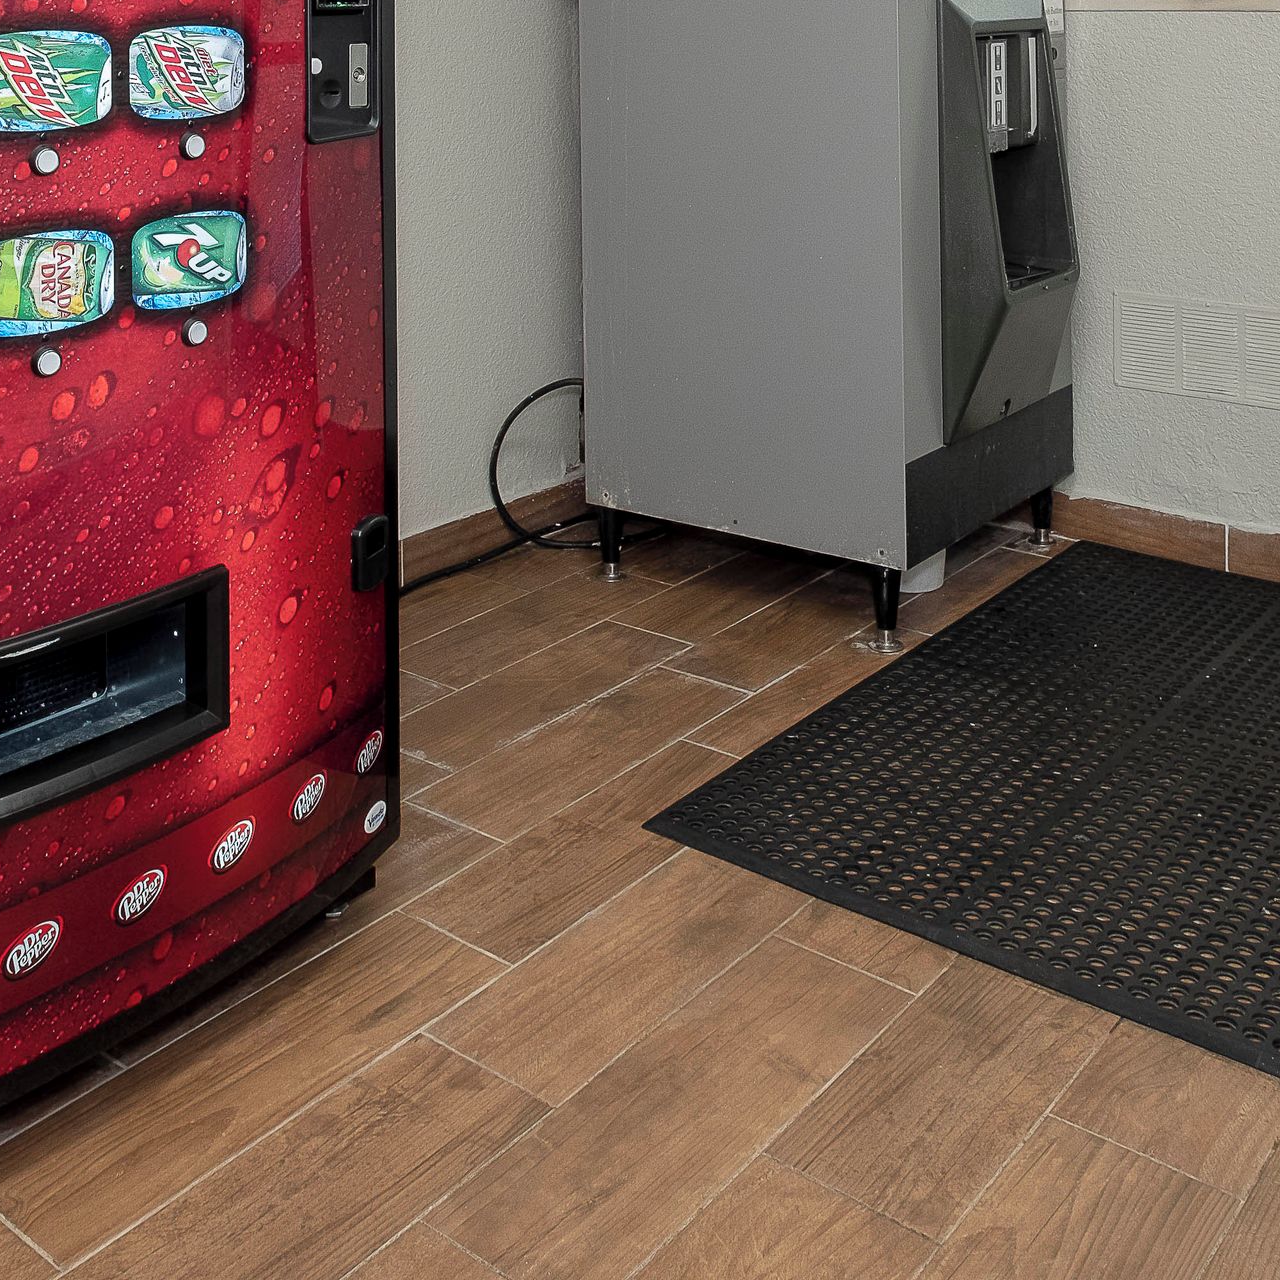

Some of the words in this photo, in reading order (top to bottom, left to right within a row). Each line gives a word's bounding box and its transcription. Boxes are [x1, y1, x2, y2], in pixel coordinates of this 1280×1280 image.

[40, 263, 56, 304] DRY
[52, 240, 75, 319] CANADA
[213, 825, 251, 869] Pepper
[226, 827, 241, 847] Dr
[118, 875, 160, 921] Pepper
[133, 877, 150, 899] Dr
[6, 927, 55, 975] Pepper
[23, 928, 42, 952] Dr
